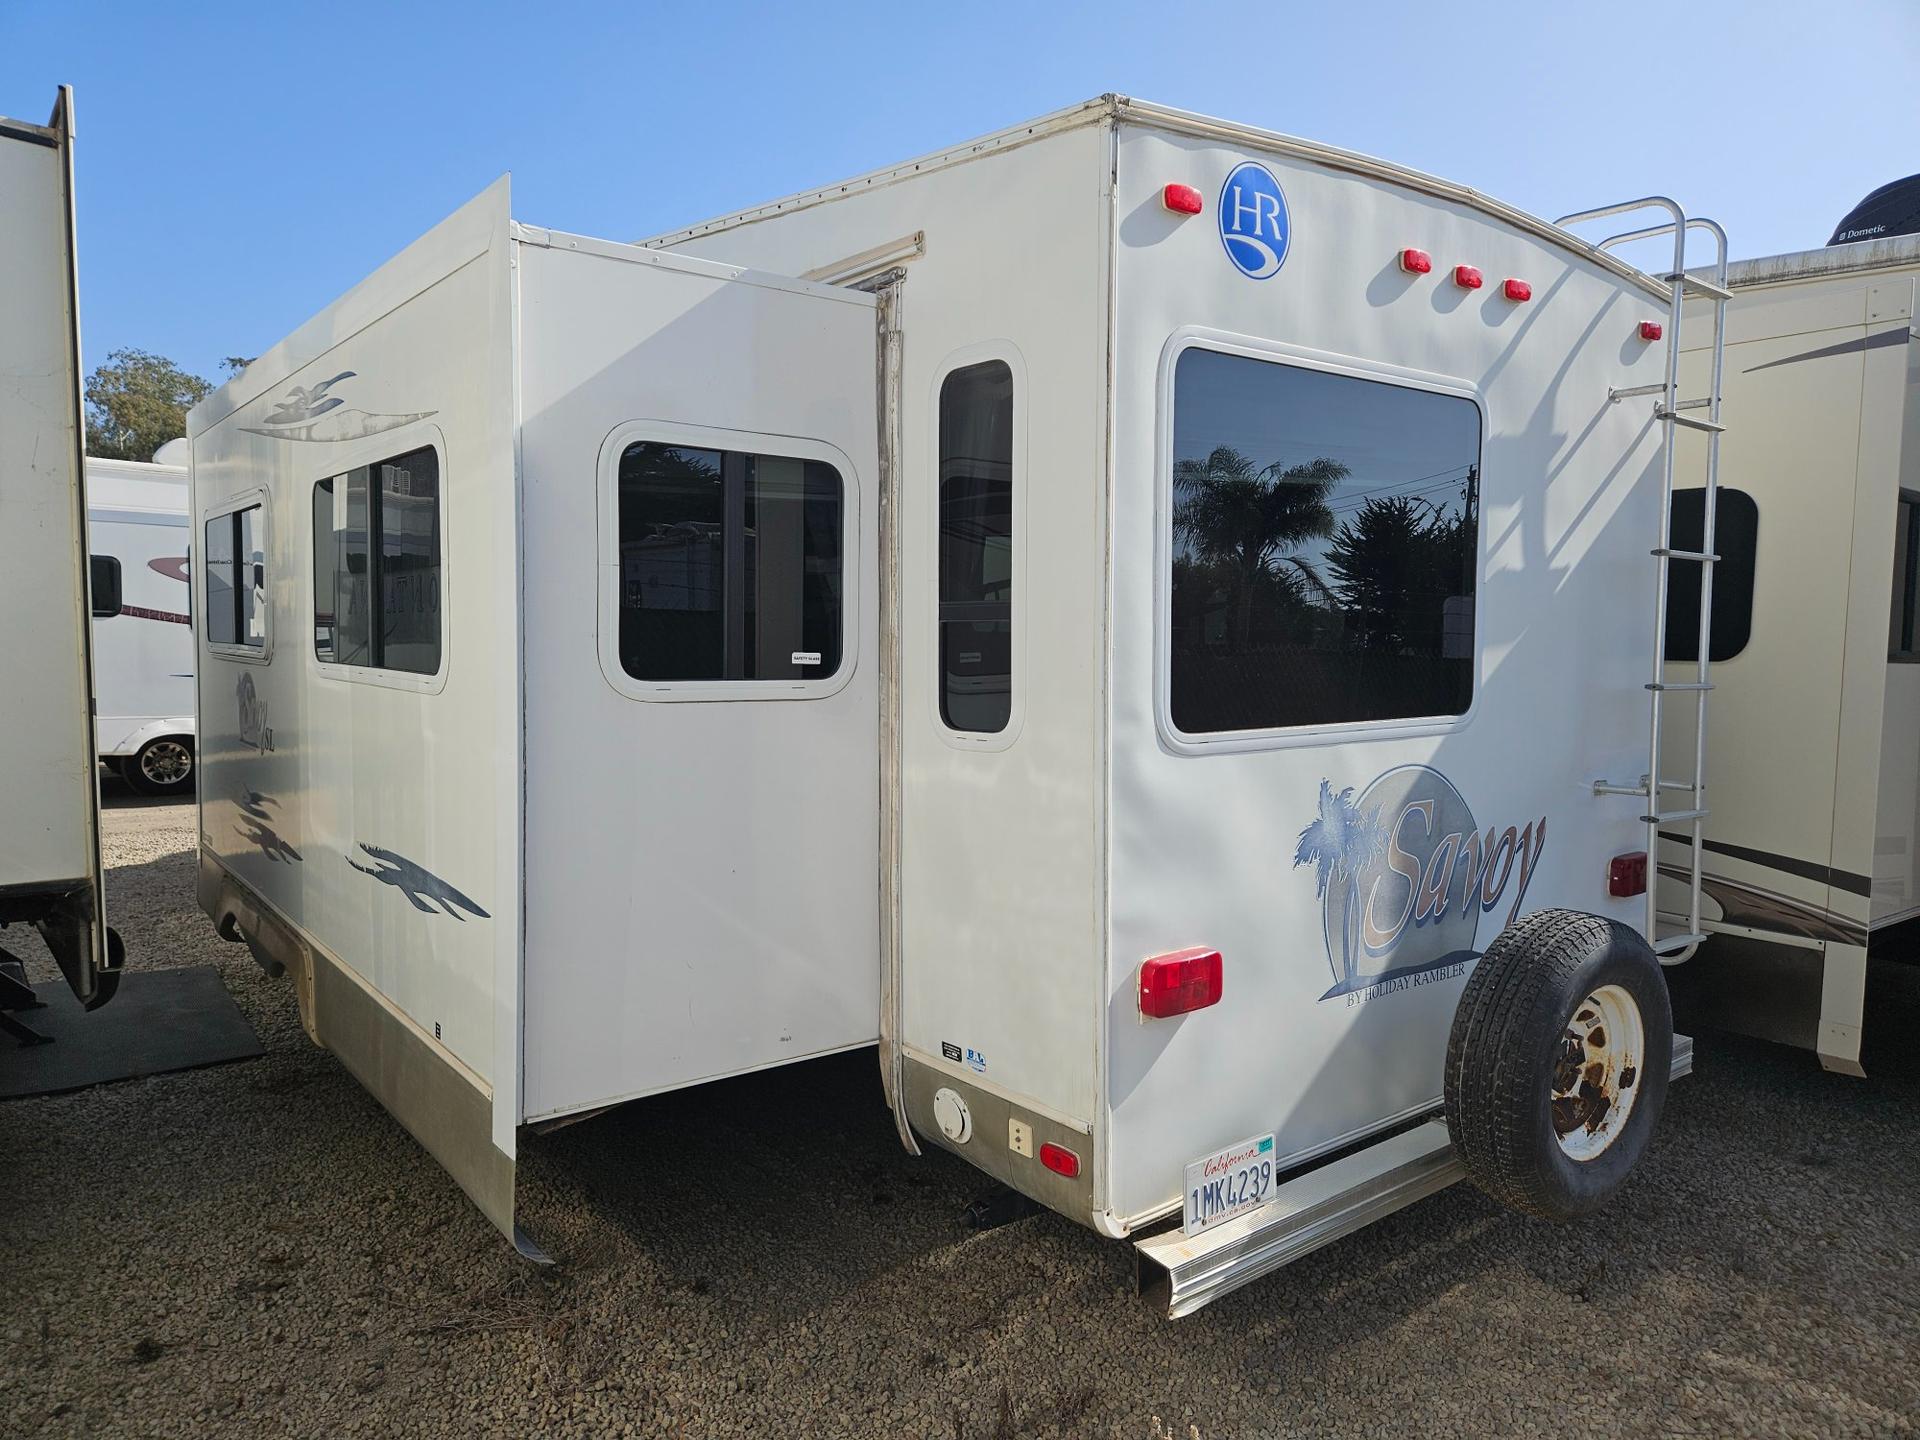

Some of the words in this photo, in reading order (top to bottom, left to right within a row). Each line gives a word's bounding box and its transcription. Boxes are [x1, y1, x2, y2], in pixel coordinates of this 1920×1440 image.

[1231, 185, 1283, 241] HR
[1847, 224, 1886, 239] Dometic
[1364, 798, 1547, 952] Savoy
[1346, 990, 1363, 1008] BY
[1364, 976, 1412, 1002] HOLIDAY
[1413, 963, 1466, 988] RAMBLER
[1204, 1148, 1261, 1176] California
[1191, 1160, 1271, 1225] 1MK4239
